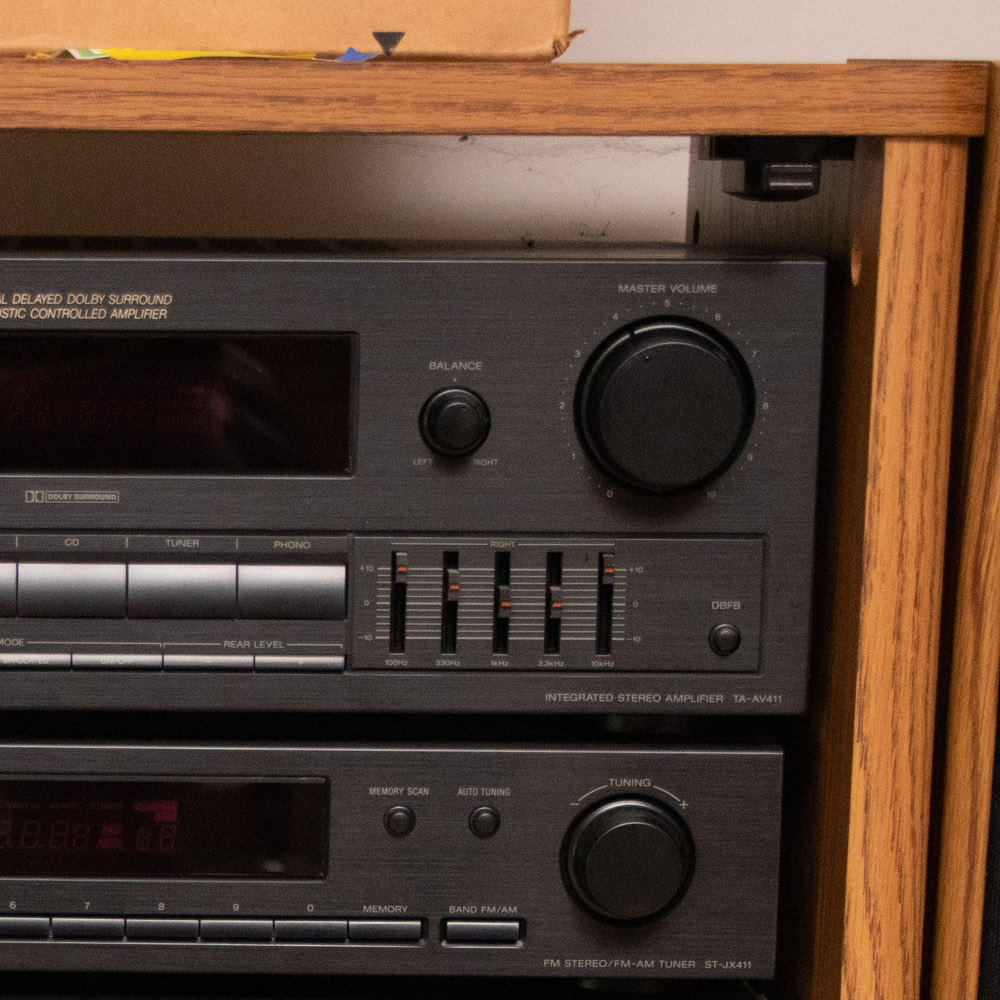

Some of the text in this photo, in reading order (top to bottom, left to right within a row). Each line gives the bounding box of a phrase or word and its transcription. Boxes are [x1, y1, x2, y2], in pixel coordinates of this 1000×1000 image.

[618, 285, 718, 293] MASTER VOLUME
[12, 293, 63, 305] DELAYED
[67, 294, 105, 305] DOLBY
[109, 295, 172, 305] SURROUND
[664, 299, 671, 307] 5
[30, 308, 107, 319] CONTROLLED
[110, 309, 168, 319] AMPLIFIER
[429, 361, 482, 370] BALANCE
[166, 539, 199, 547] TUNER
[274, 541, 311, 549] PHONO
[712, 601, 740, 609] DBFB
[224, 640, 250, 648] REAR
[545, 694, 783, 703] INTEGRATED STEREO AMPLIFIER TA-AV411
[609, 779, 651, 788] TUNING
[407, 788, 429, 796] SCAN
[458, 788, 510, 796] AUTO TUNING
[363, 905, 408, 913] MEMORY
[449, 906, 518, 914] BAND FM/AM
[660, 960, 696, 969] TUNER
[704, 961, 752, 970] ST-JX411
